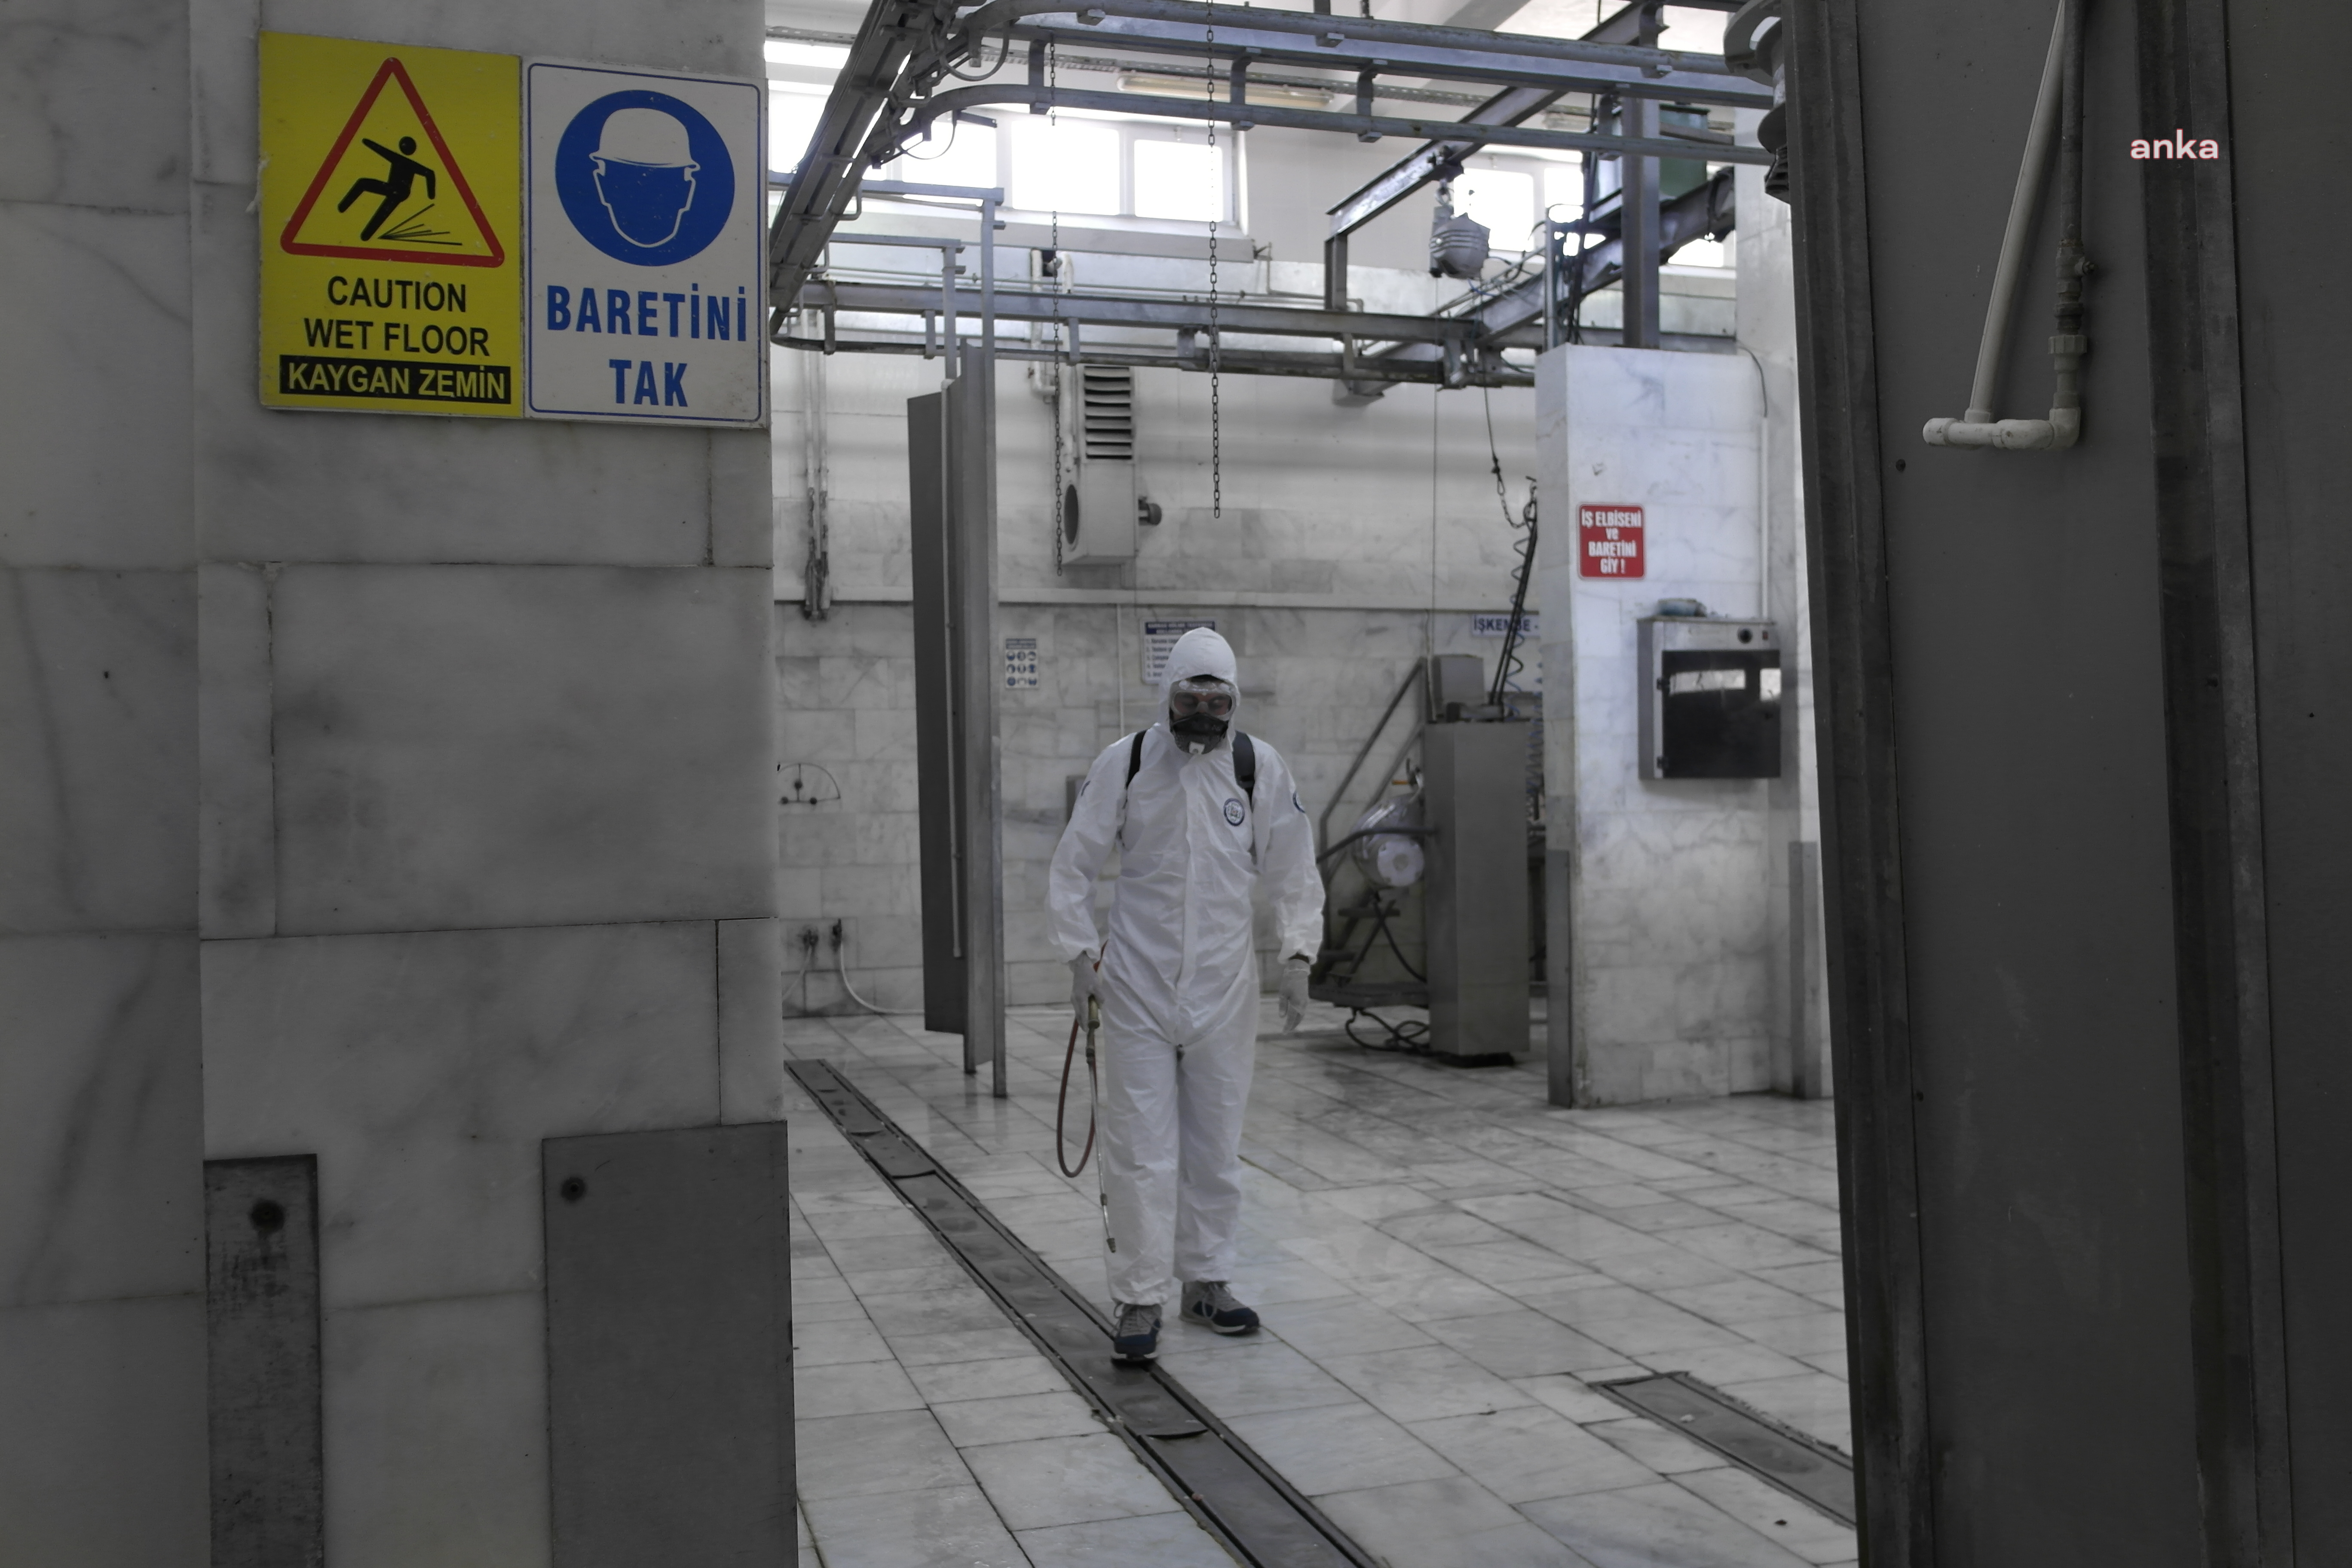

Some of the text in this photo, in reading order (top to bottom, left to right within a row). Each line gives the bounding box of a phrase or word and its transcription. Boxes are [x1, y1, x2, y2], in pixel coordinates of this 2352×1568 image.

[327, 276, 466, 312] CAUTION
[547, 283, 746, 342] BARETİNİ
[304, 317, 490, 357] WET FLOOR
[288, 362, 505, 400] KAYGAN ZEMİN
[609, 359, 688, 407] TAK
[1582, 509, 1642, 528] İŞ ELBİSENİ
[1589, 540, 1636, 557] BARETİNİ
[1600, 557, 1618, 574] GİY
